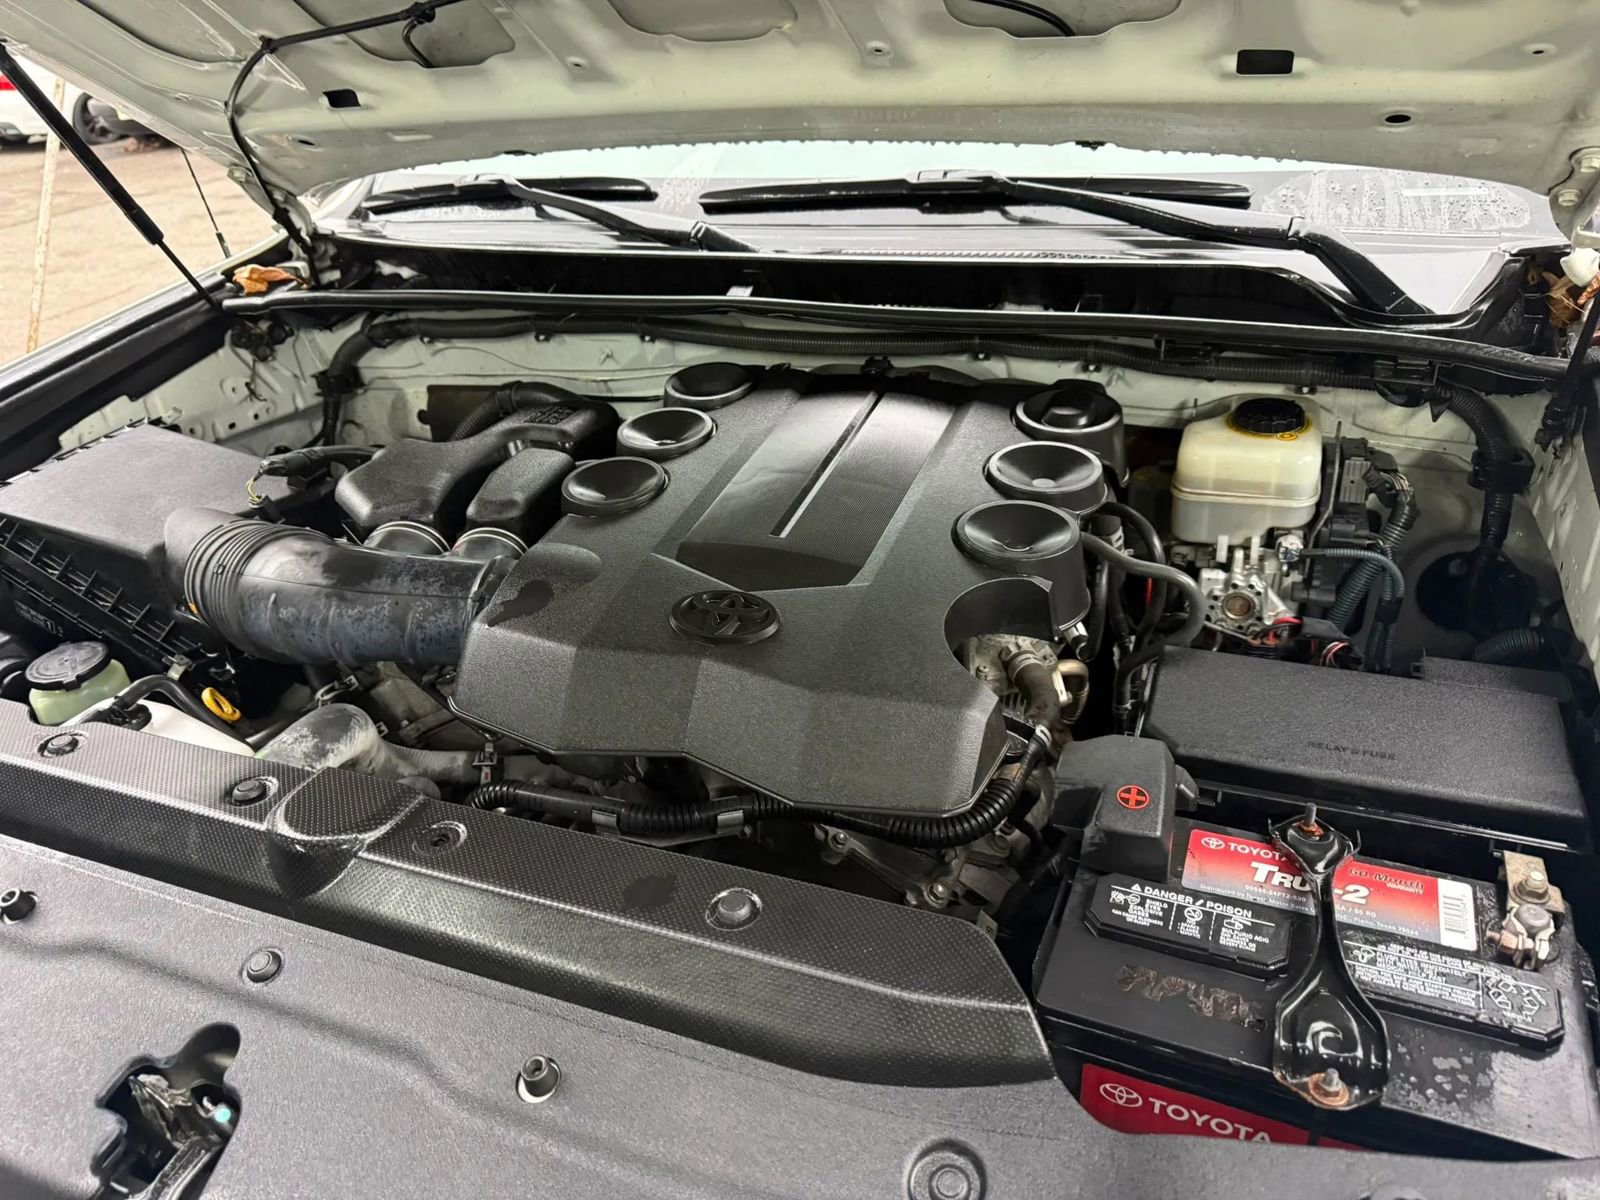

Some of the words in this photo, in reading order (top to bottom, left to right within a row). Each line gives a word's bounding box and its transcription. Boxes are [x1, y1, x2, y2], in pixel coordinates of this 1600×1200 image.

[1228, 842, 1288, 861] TOYOT
[1144, 886, 1194, 905] DANGER
[1206, 901, 1252, 918] POISON
[1149, 1097, 1272, 1143] TOYOTA
